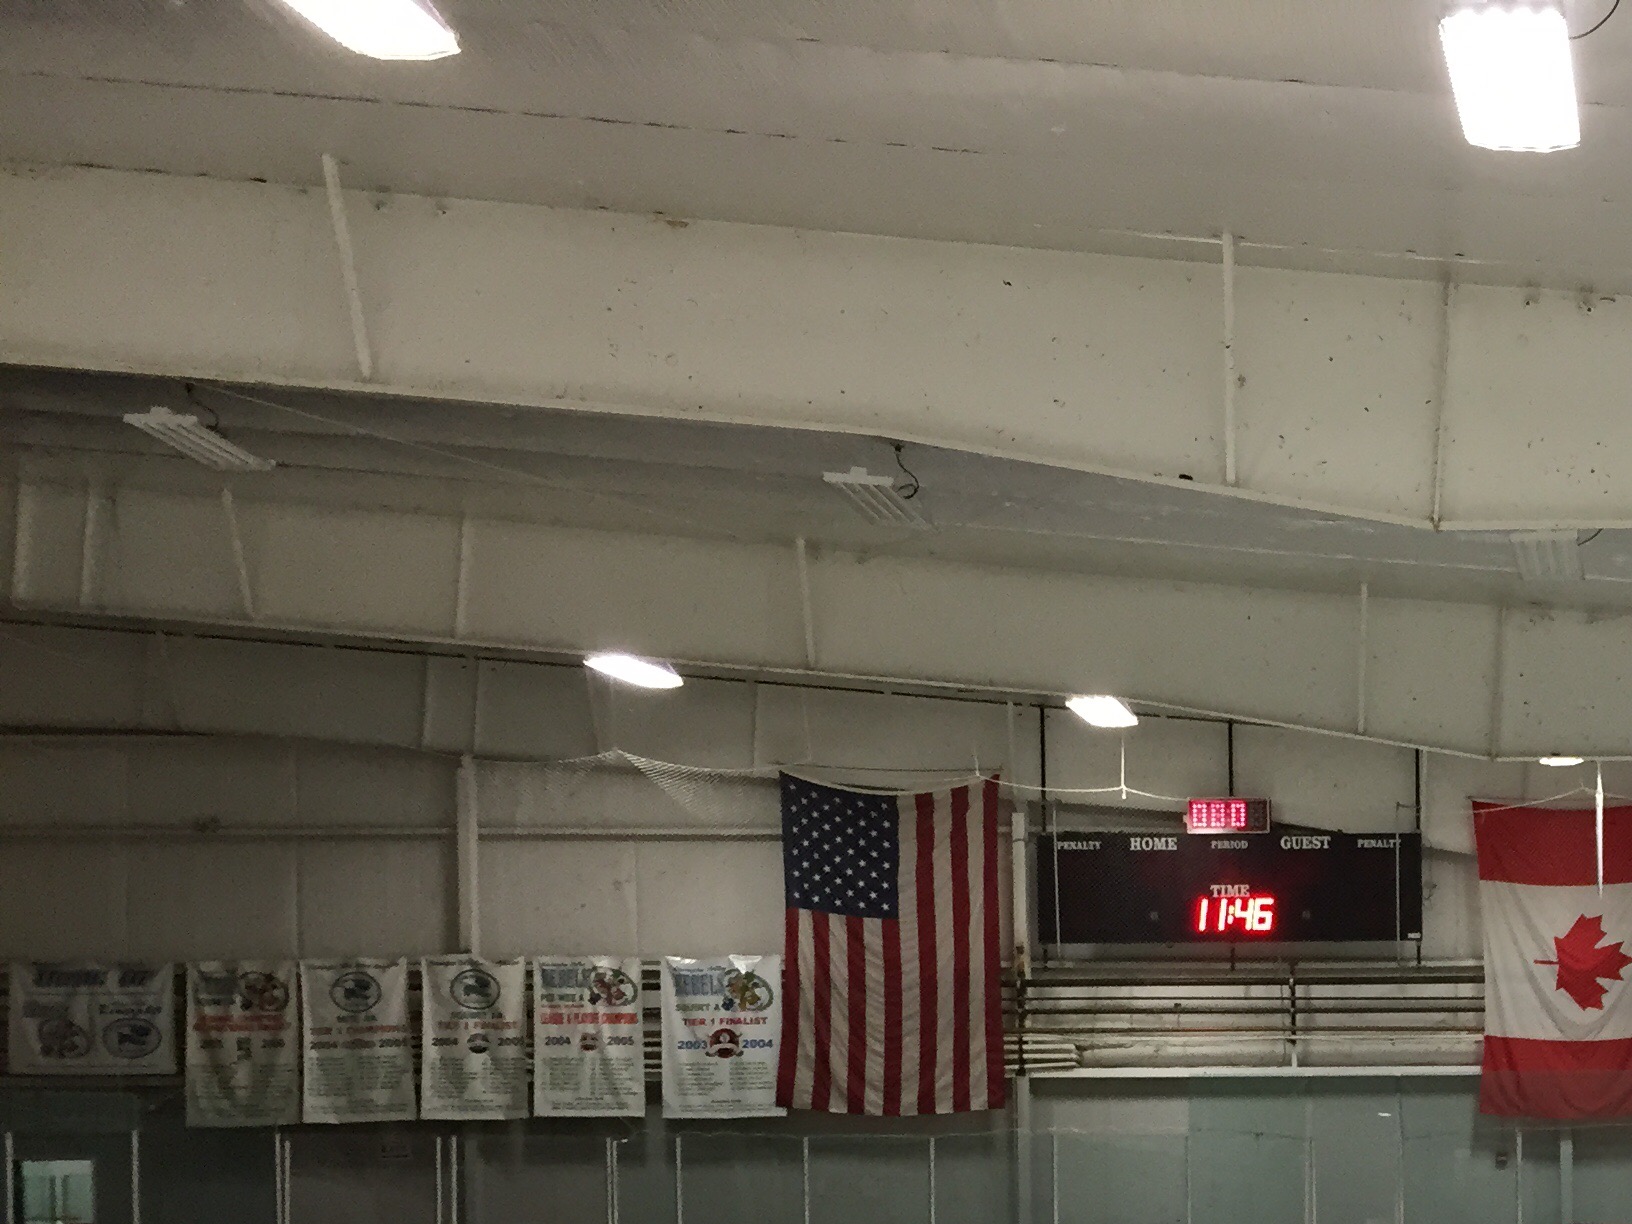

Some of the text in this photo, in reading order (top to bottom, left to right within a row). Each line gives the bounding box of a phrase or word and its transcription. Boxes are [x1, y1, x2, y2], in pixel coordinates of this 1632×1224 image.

[1057, 840, 1102, 851] PENALTY
[1129, 837, 1178, 851] HOME
[1210, 840, 1249, 850] PERIOD
[1280, 835, 1331, 850] GUEST
[1210, 884, 1250, 898] TIME
[1198, 897, 1275, 932] 11:46
[682, 1018, 707, 1026] TIER
[719, 1016, 768, 1026] FINALIST
[677, 1041, 708, 1050] 2003
[742, 1039, 773, 1049] 2004
